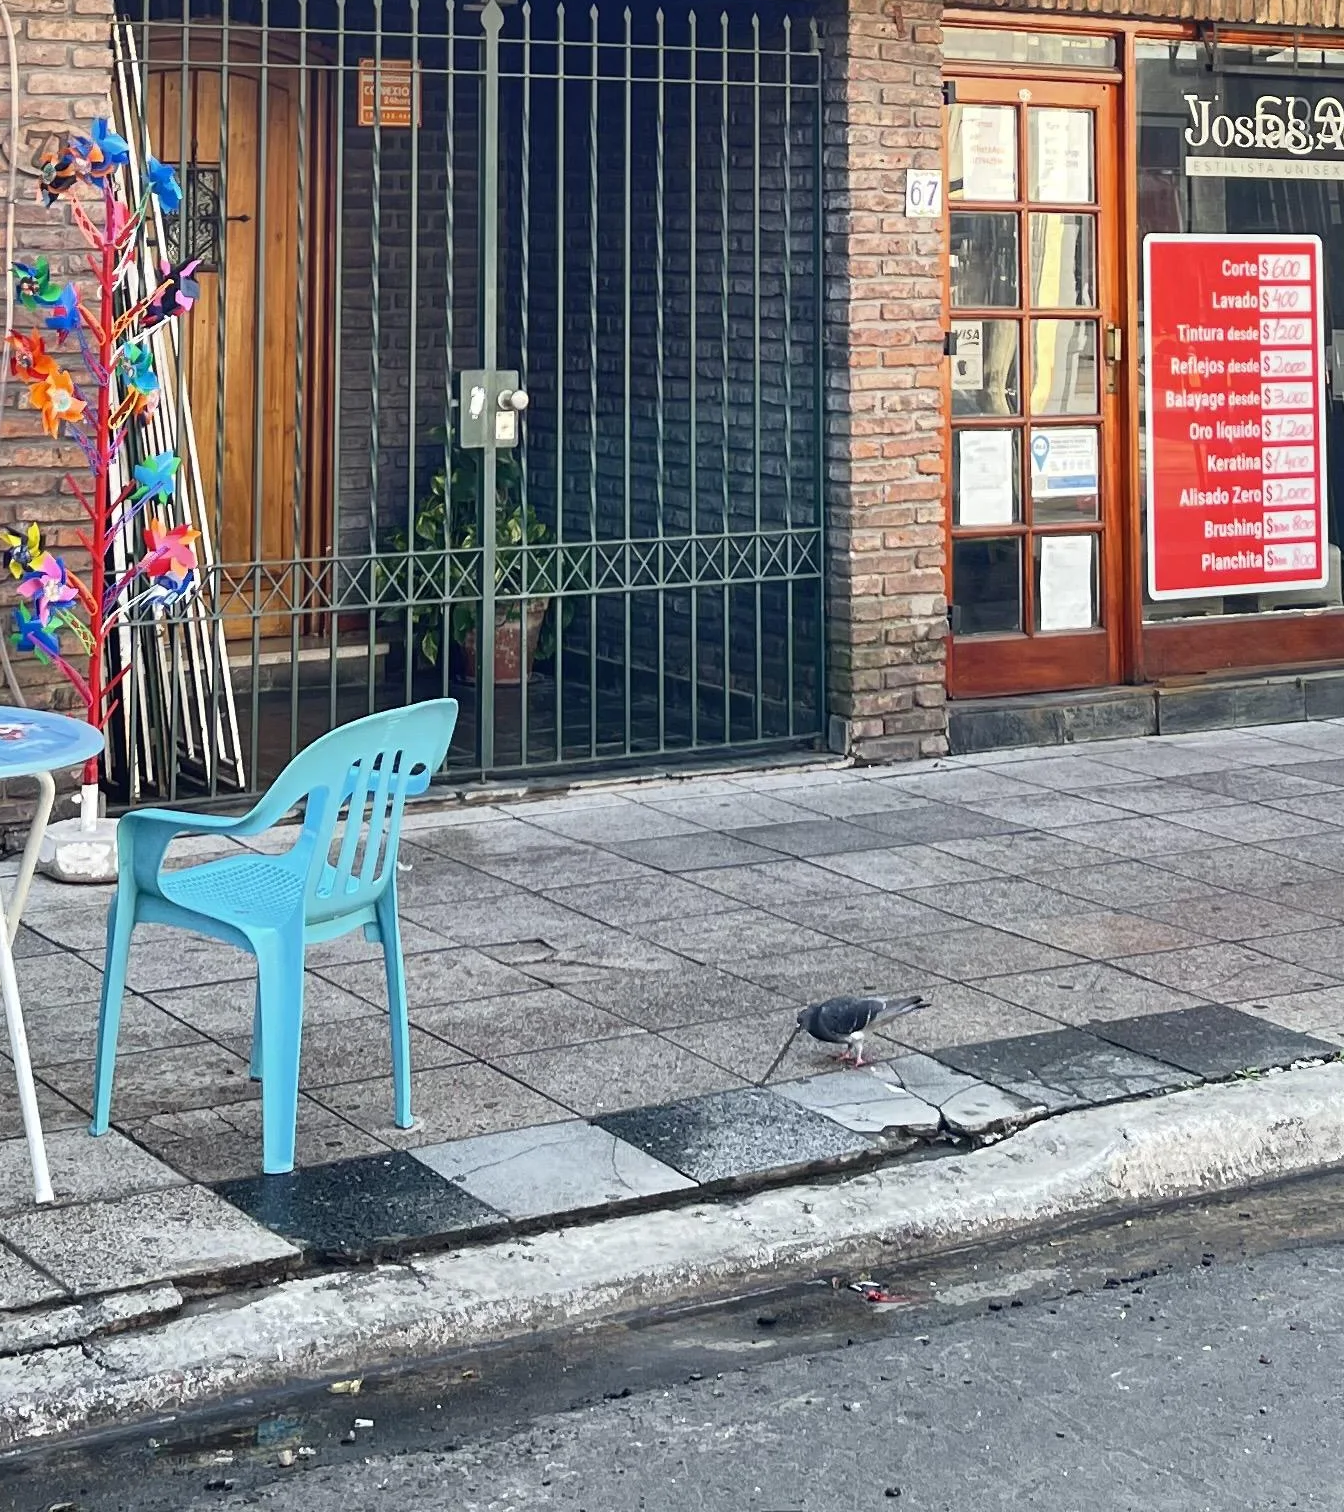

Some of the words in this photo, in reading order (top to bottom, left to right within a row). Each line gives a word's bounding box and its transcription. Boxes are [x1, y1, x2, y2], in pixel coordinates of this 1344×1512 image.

[1192, 160, 1276, 176] ESTILISTA
[1284, 163, 1343, 178] UNISEX
[910, 179, 939, 207] 67
[1221, 259, 1259, 277] Corte
[1211, 290, 1259, 310] Lavado
[1176, 324, 1225, 343] Tintura
[1227, 326, 1260, 342] desde
[1170, 355, 1225, 379] Reflejos
[1227, 358, 1260, 374] desde
[1164, 389, 1226, 412] Balayage
[1228, 390, 1261, 407] desde
[1188, 421, 1214, 441] Oro
[1216, 418, 1262, 442] líquido
[1207, 453, 1262, 473] Keratina
[1178, 486, 1230, 508] Alisado
[1231, 485, 1262, 504] Zero
[1203, 518, 1263, 540] Brushing
[1200, 549, 1264, 573] Planchita
